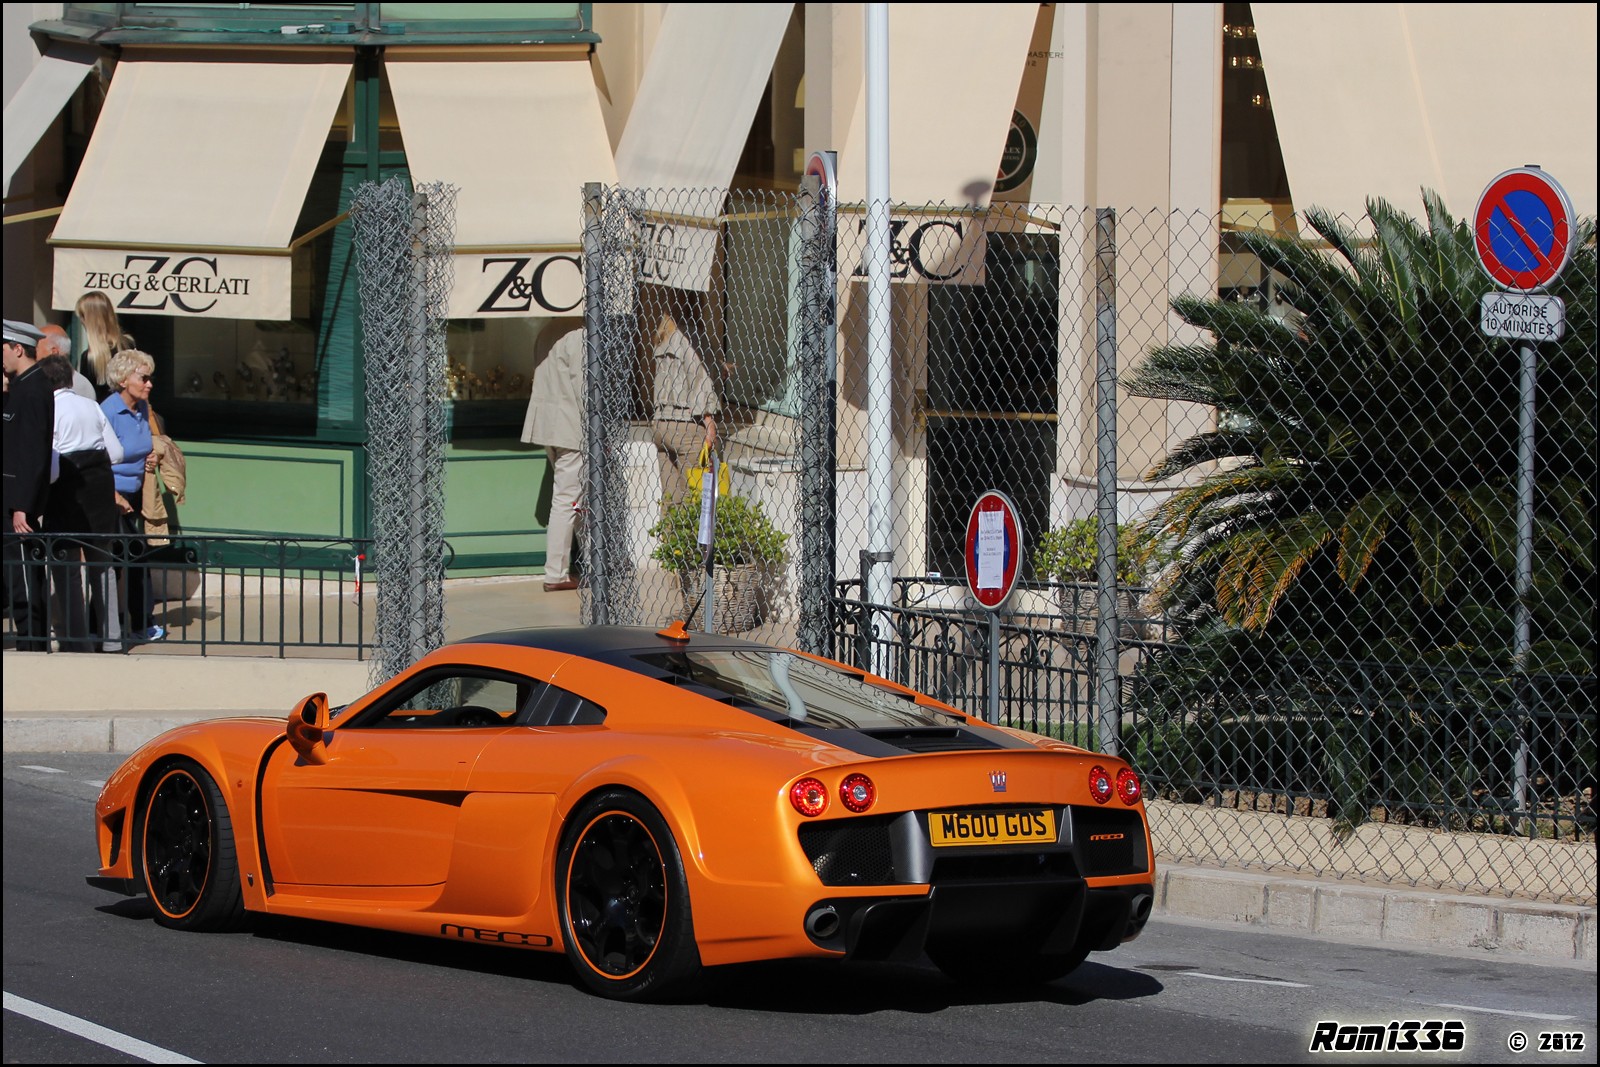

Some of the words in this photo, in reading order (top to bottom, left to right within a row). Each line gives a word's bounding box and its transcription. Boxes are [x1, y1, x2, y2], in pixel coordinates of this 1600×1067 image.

[84, 272, 141, 290] ZEGG
[144, 275, 160, 291] &
[162, 275, 250, 295] CERLATI
[477, 255, 586, 312] Z&C
[1492, 302, 1547, 318] AUTORISE
[1486, 318, 1498, 330] 10
[1504, 320, 1554, 335] MINUTES
[942, 814, 999, 838] M600
